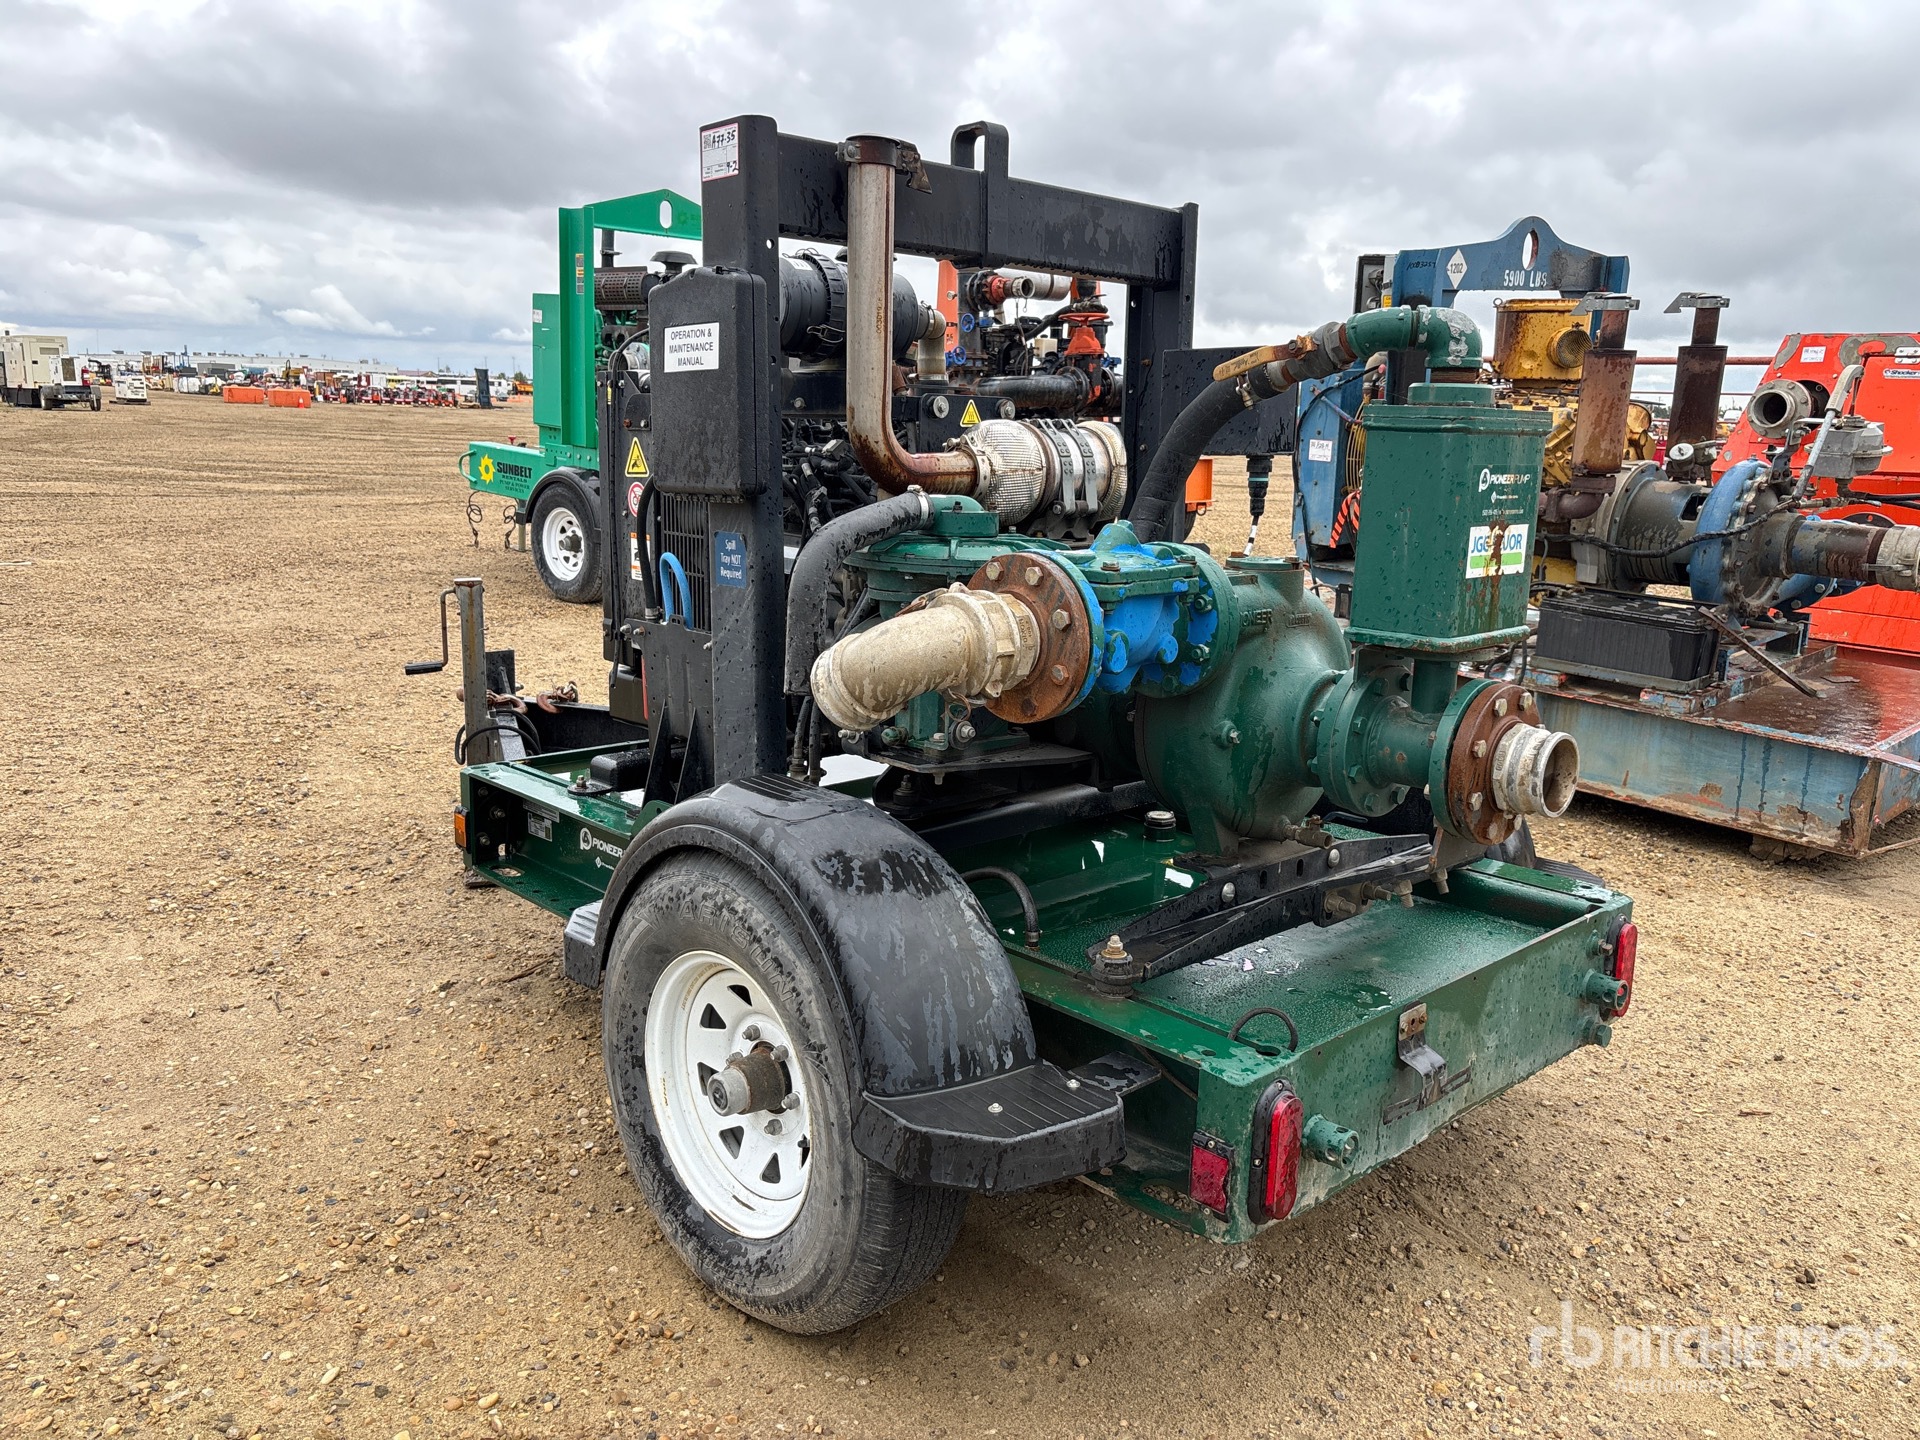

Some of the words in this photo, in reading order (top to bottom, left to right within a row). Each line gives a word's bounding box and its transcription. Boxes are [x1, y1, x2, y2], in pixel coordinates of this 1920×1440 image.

[1450, 263, 1463, 274] 1202
[1503, 270, 1525, 287] 5900
[1529, 270, 1547, 287] LBS
[670, 329, 706, 341] OPERATION
[707, 328, 712, 338] &
[669, 341, 714, 354] MAINTENANCE
[677, 356, 704, 367] MANUAL
[496, 461, 532, 479] SUNBELT
[501, 474, 528, 483] RENTALS
[725, 539, 737, 551] Spill
[720, 552, 731, 566] Tray
[731, 554, 742, 565] NOT
[720, 566, 742, 580] Required
[592, 837, 627, 858] PIONEER
